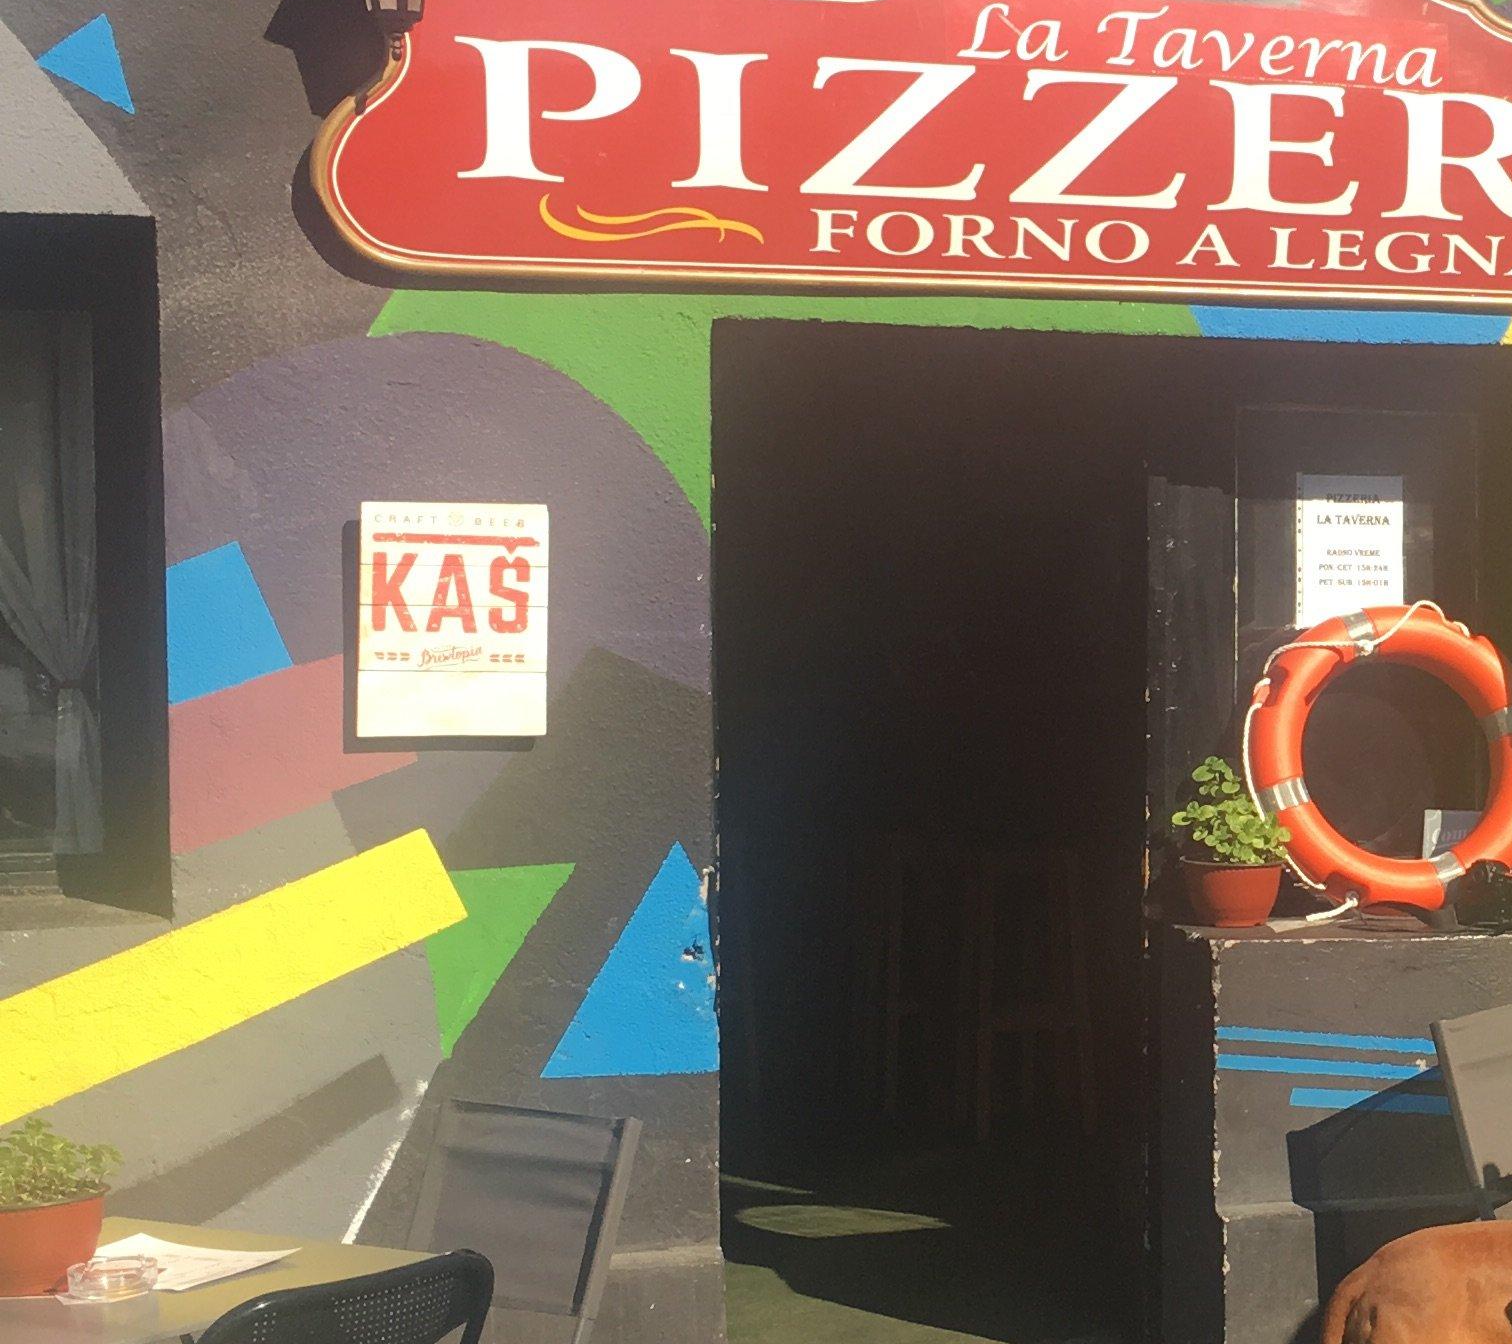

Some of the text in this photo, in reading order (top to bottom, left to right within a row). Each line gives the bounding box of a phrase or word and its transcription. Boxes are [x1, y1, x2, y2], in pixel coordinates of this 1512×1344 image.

[957, 2, 1443, 88] La Taverna
[808, 208, 1151, 264] FORNO
[1176, 222, 1242, 267] A
[374, 514, 437, 525] CRAFT
[1316, 514, 1391, 526] LA TAVERNA
